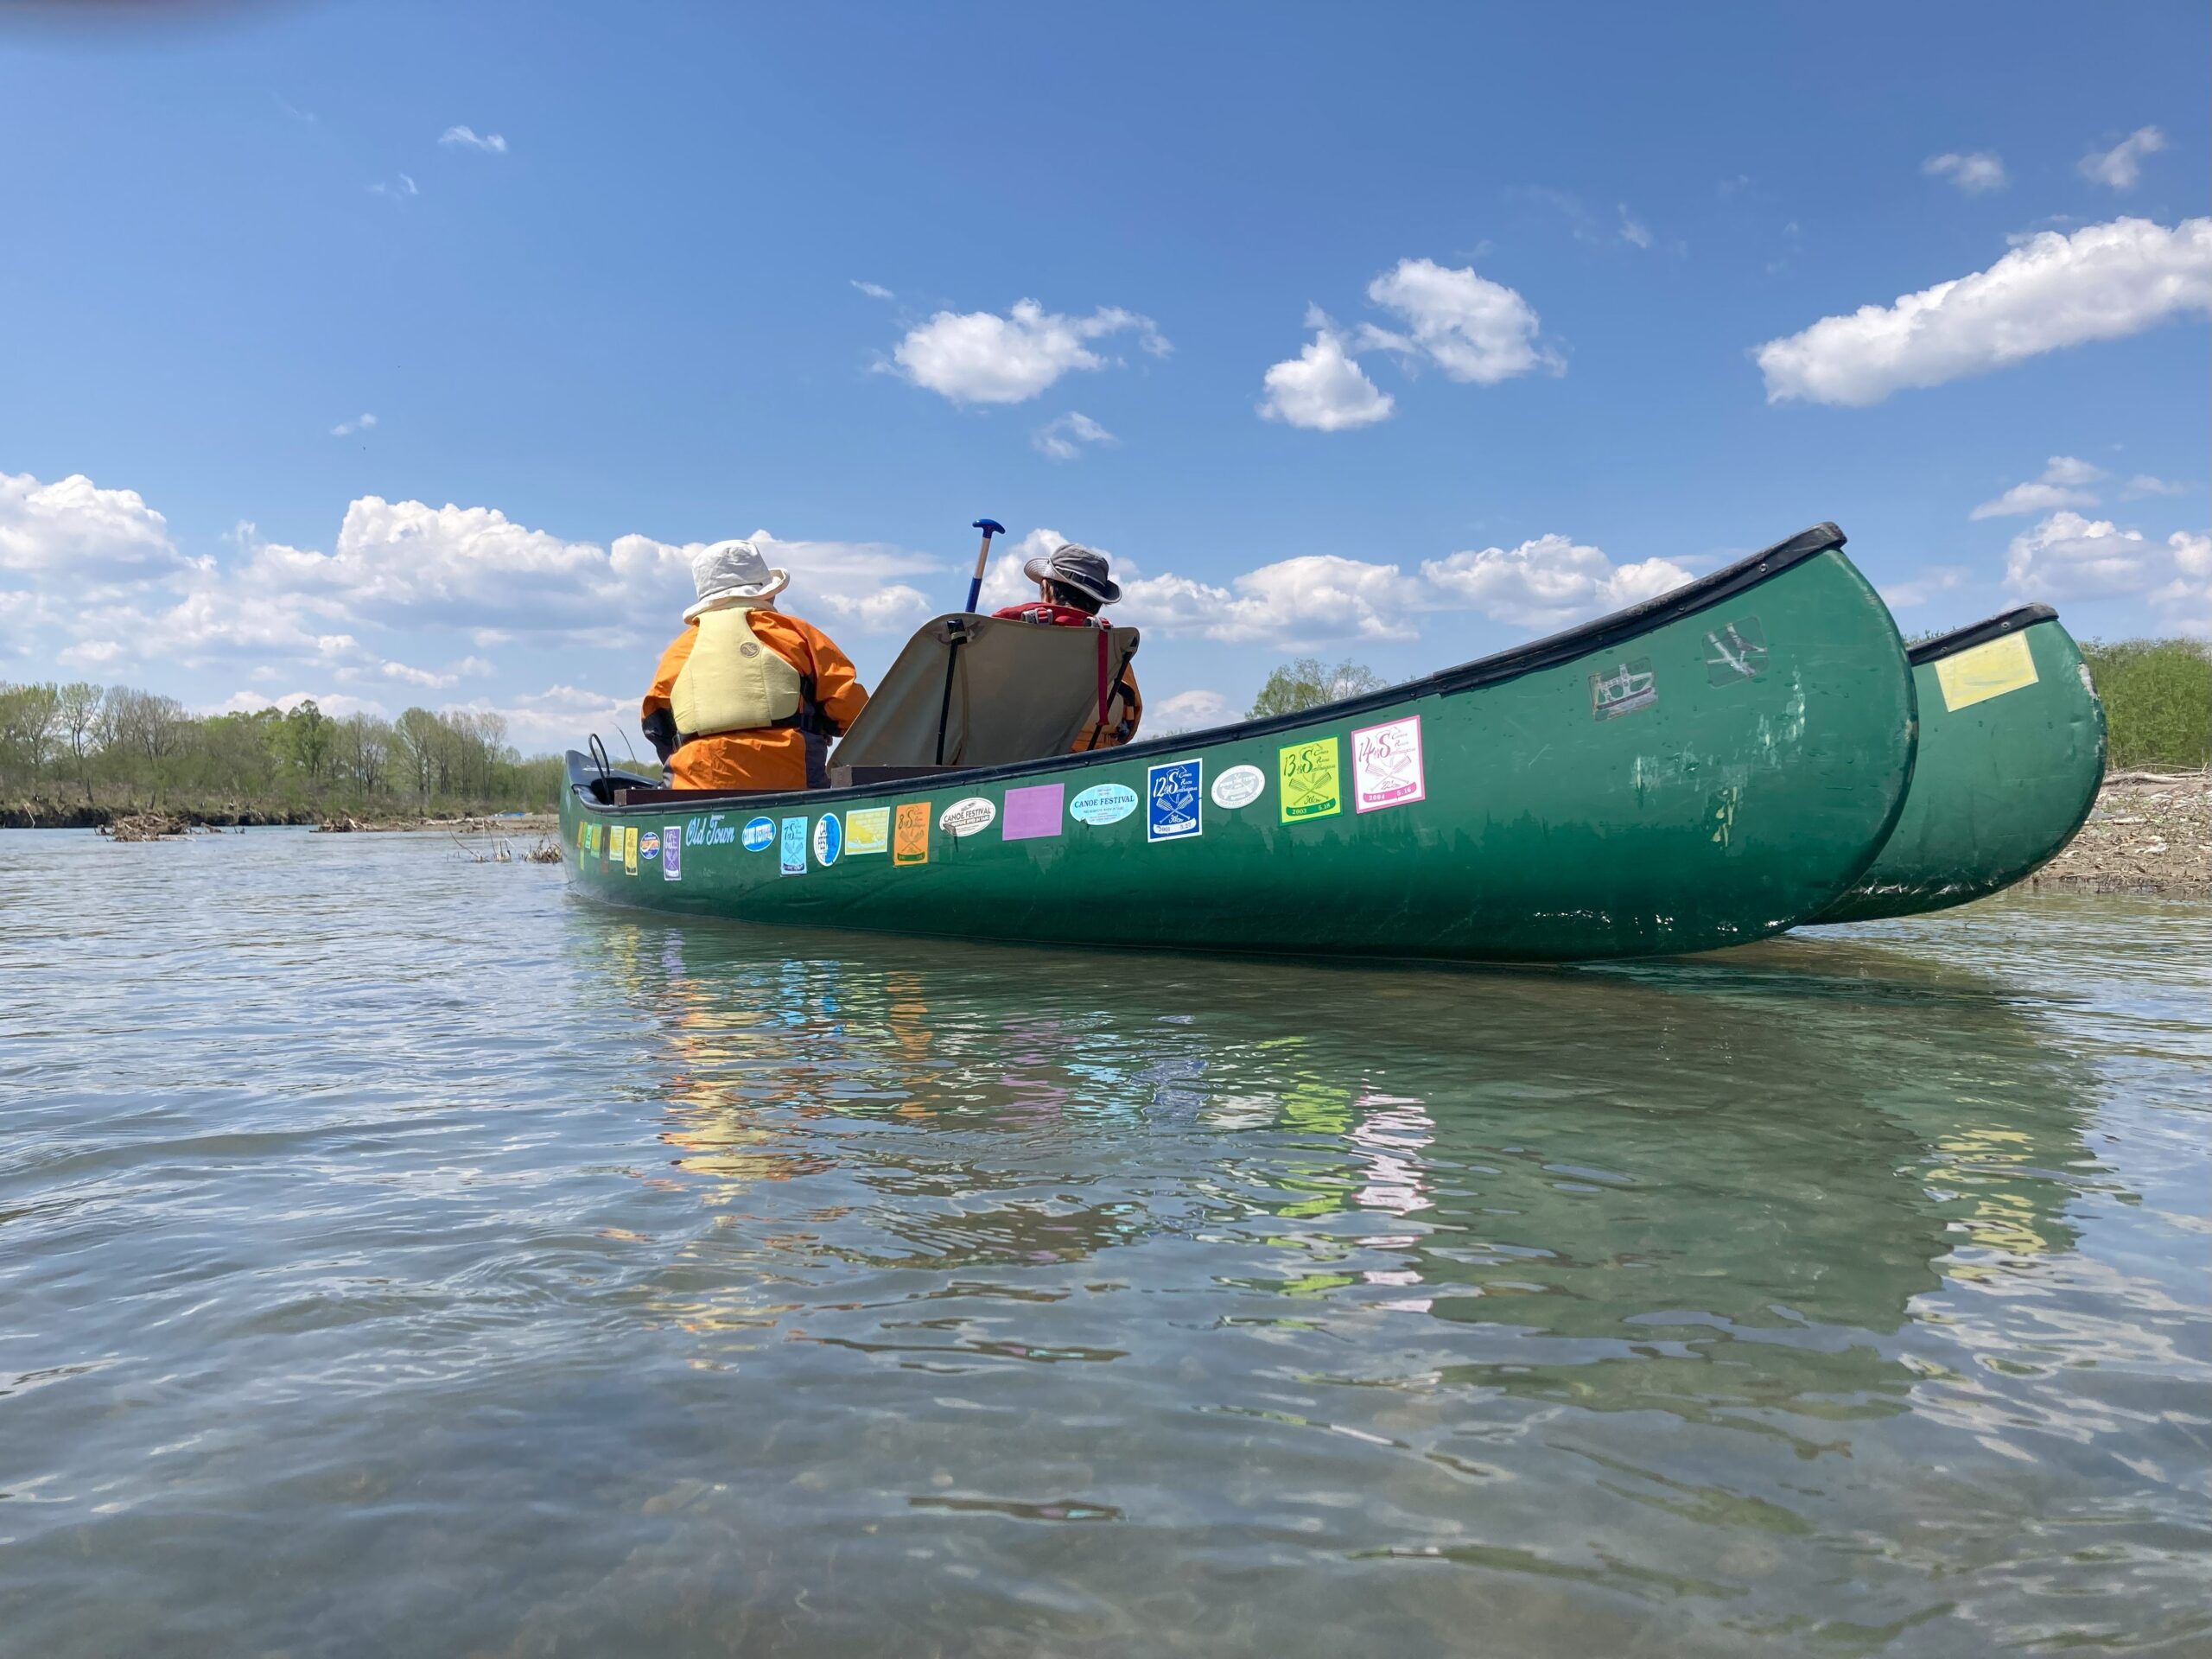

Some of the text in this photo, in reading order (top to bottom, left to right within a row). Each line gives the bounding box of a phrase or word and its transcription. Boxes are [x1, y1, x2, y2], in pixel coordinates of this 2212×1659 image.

[1074, 795, 1135, 809] CANOE FESTIVAL
[944, 807, 991, 823] CANOE FESTIVAL
[685, 816, 707, 847] Old
[706, 814, 735, 846] Town
